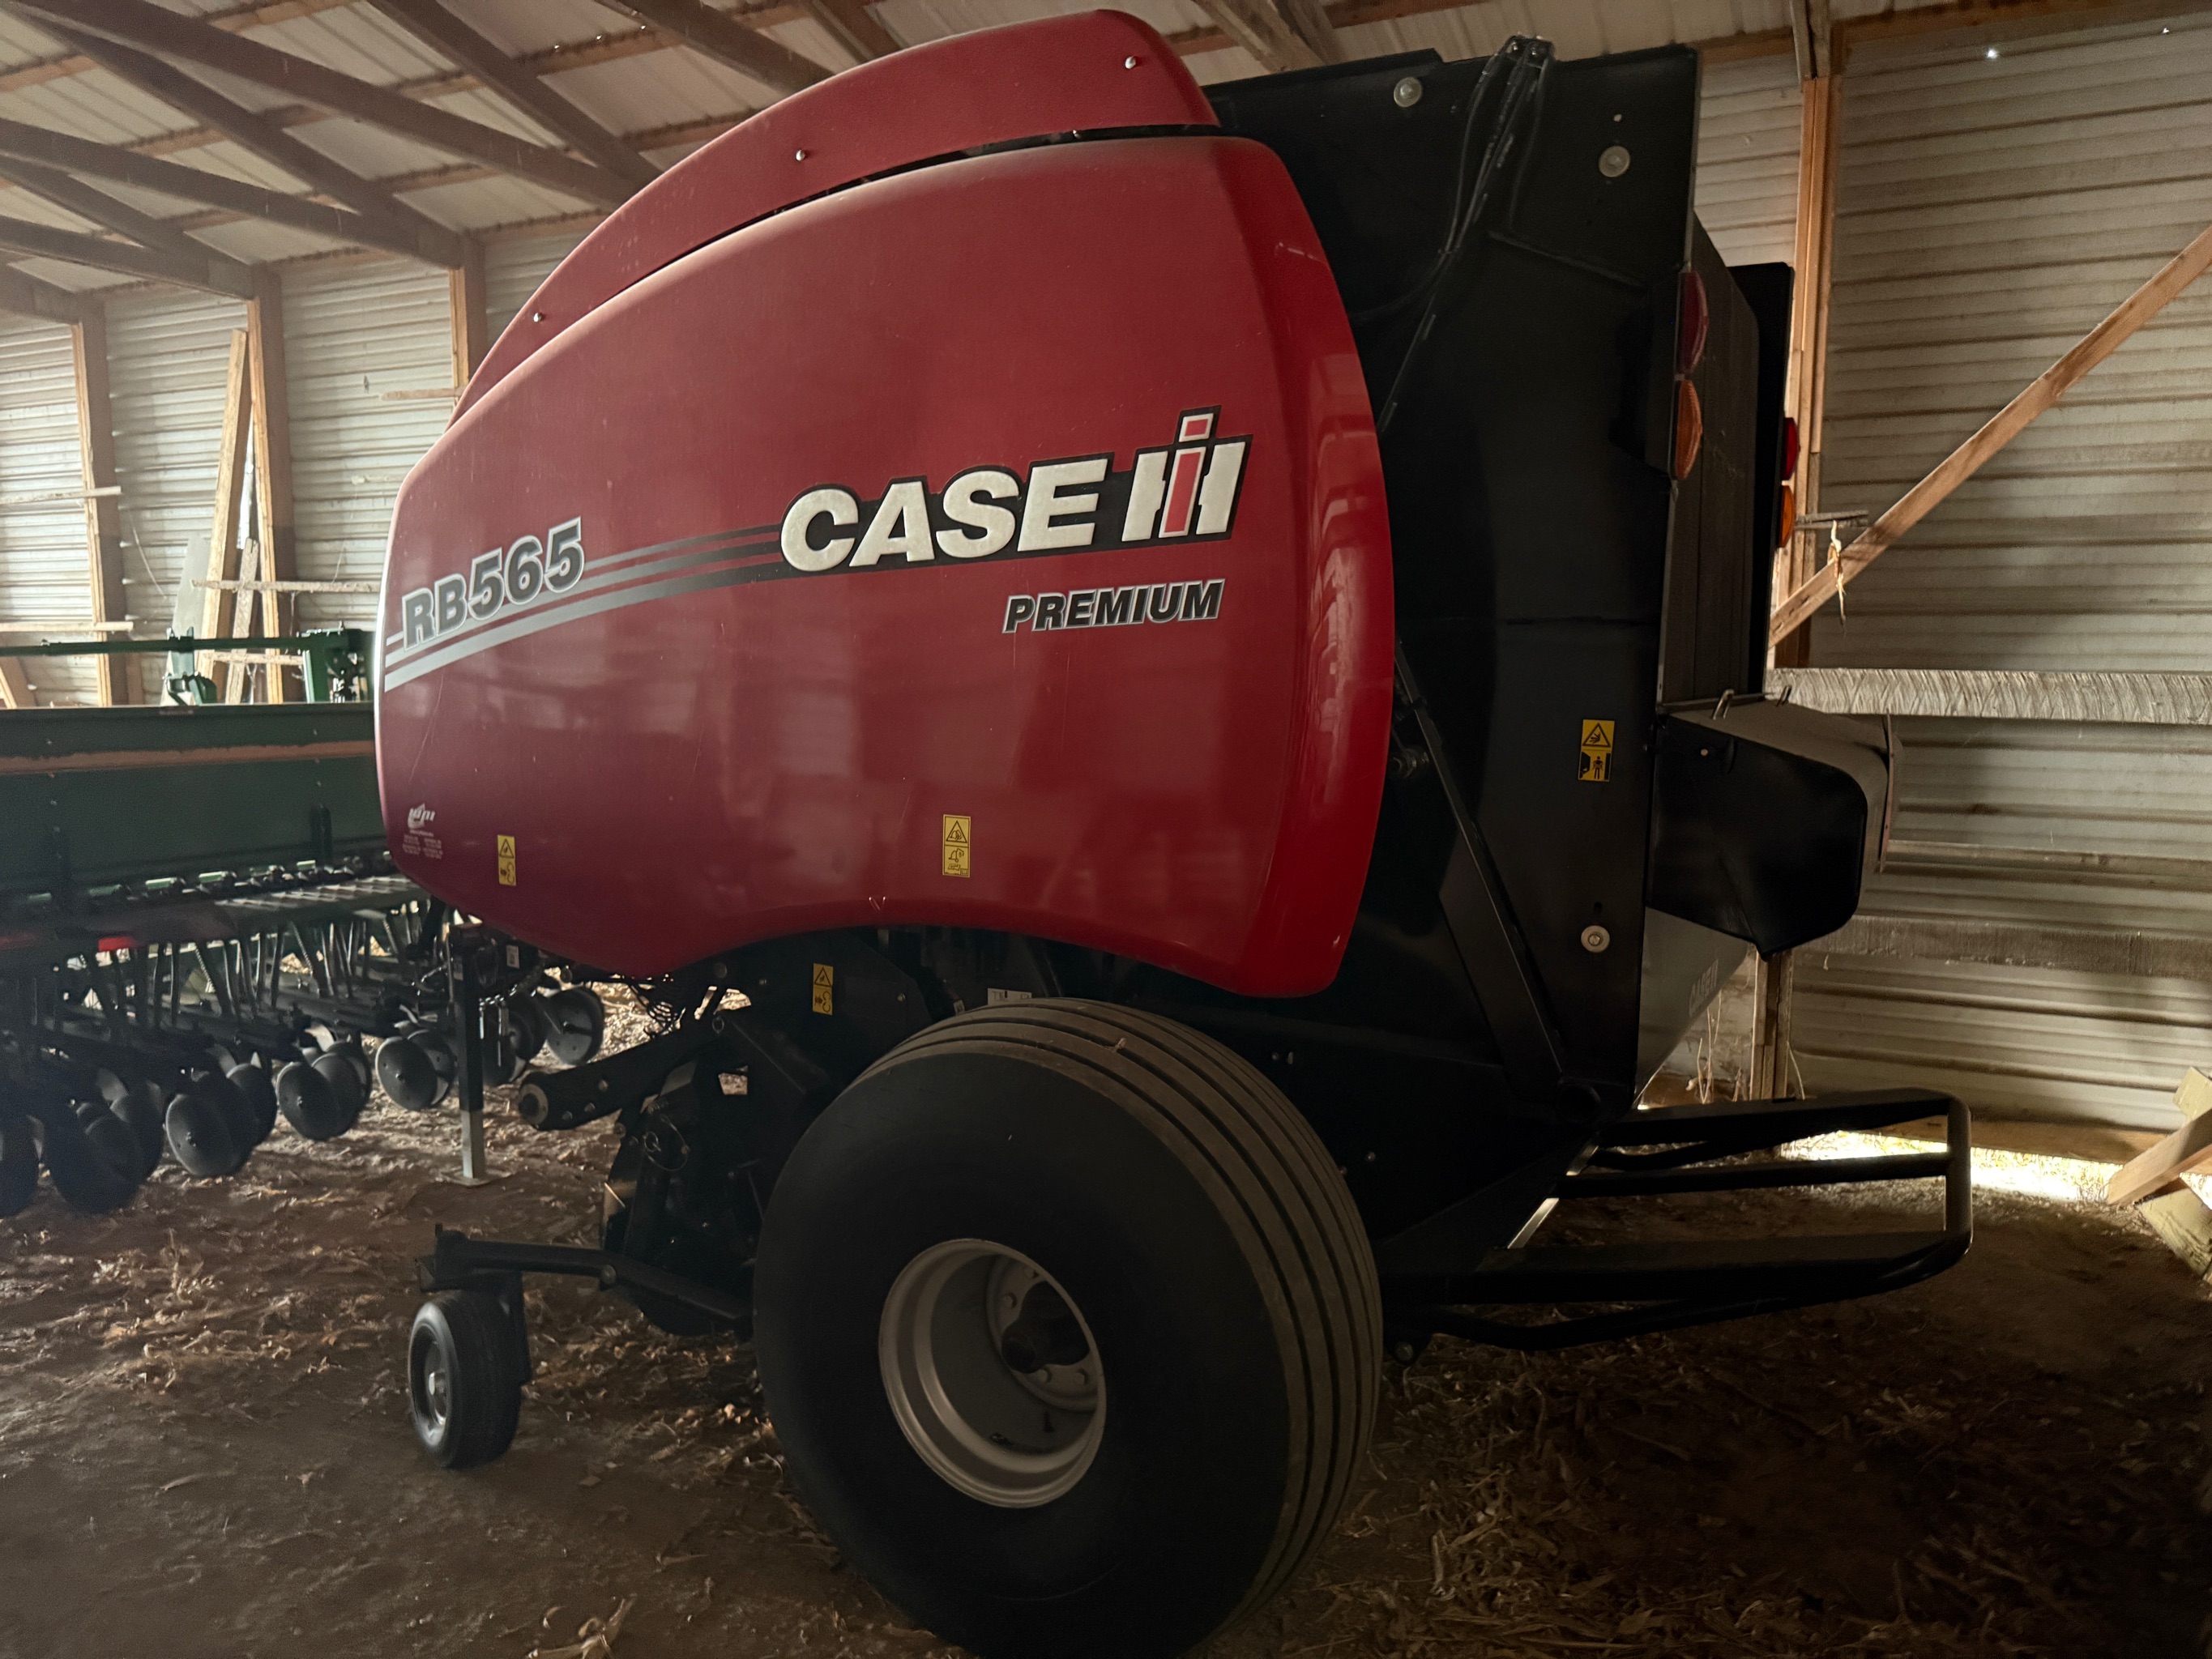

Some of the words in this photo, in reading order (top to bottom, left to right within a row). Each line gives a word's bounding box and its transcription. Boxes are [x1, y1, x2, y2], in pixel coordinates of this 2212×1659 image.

[779, 457, 1108, 572] CASE
[402, 515, 585, 652] RB565
[1002, 578, 1226, 634] PREMIUM
